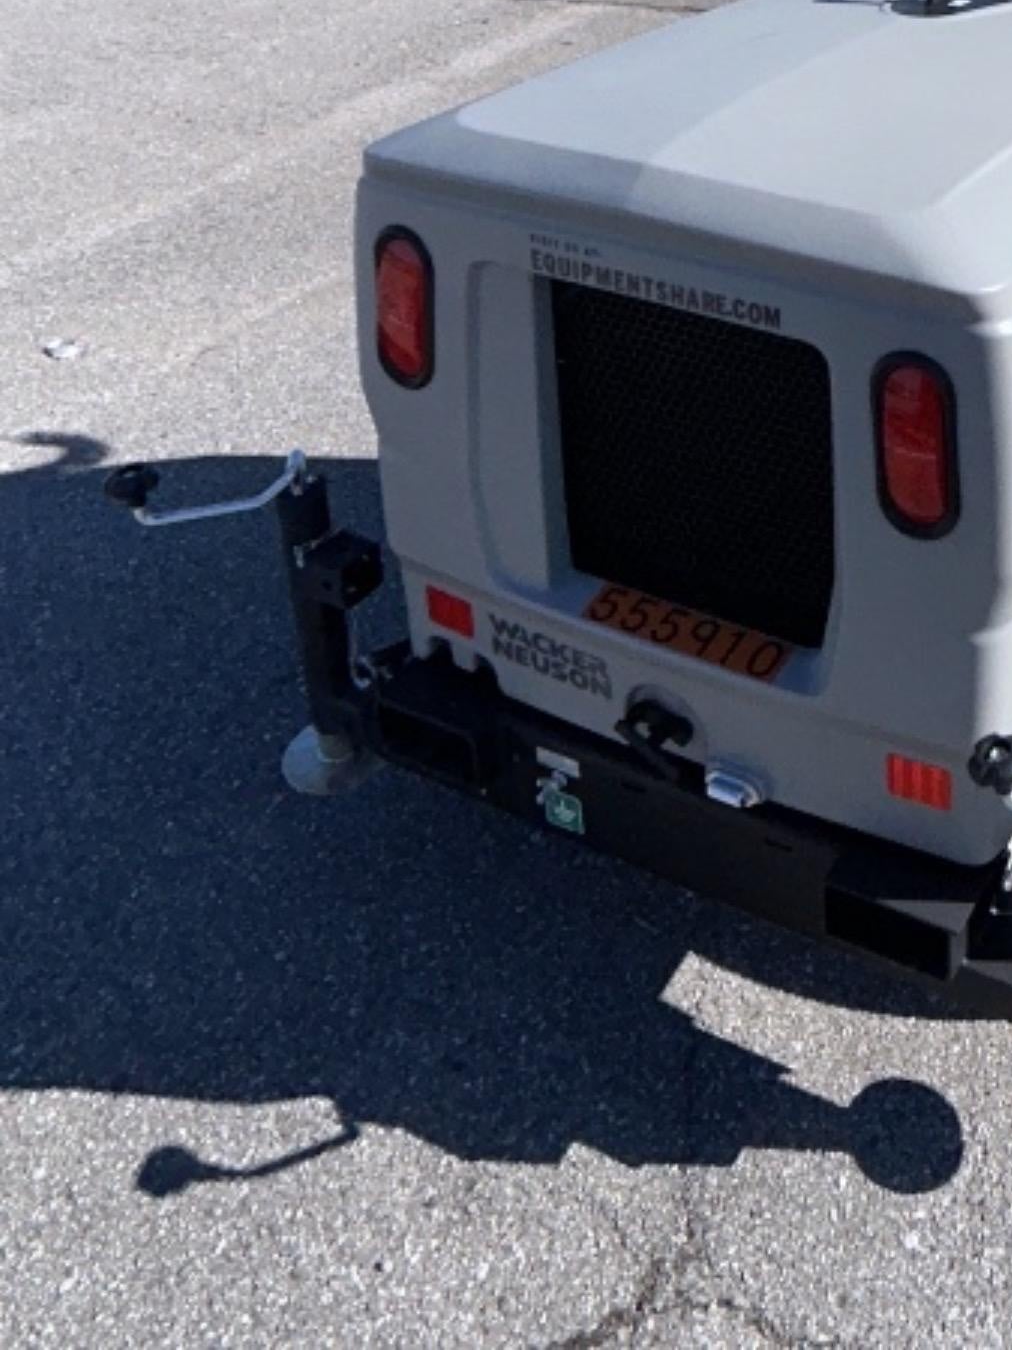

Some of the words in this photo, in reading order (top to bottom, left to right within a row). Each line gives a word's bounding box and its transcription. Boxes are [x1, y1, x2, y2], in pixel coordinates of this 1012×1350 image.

[530, 248, 782, 328] EQUIPMENTSHARE.COM
[489, 613, 606, 672] WACKER
[492, 634, 613, 700] NEUSON
[590, 586, 784, 676] 555910
